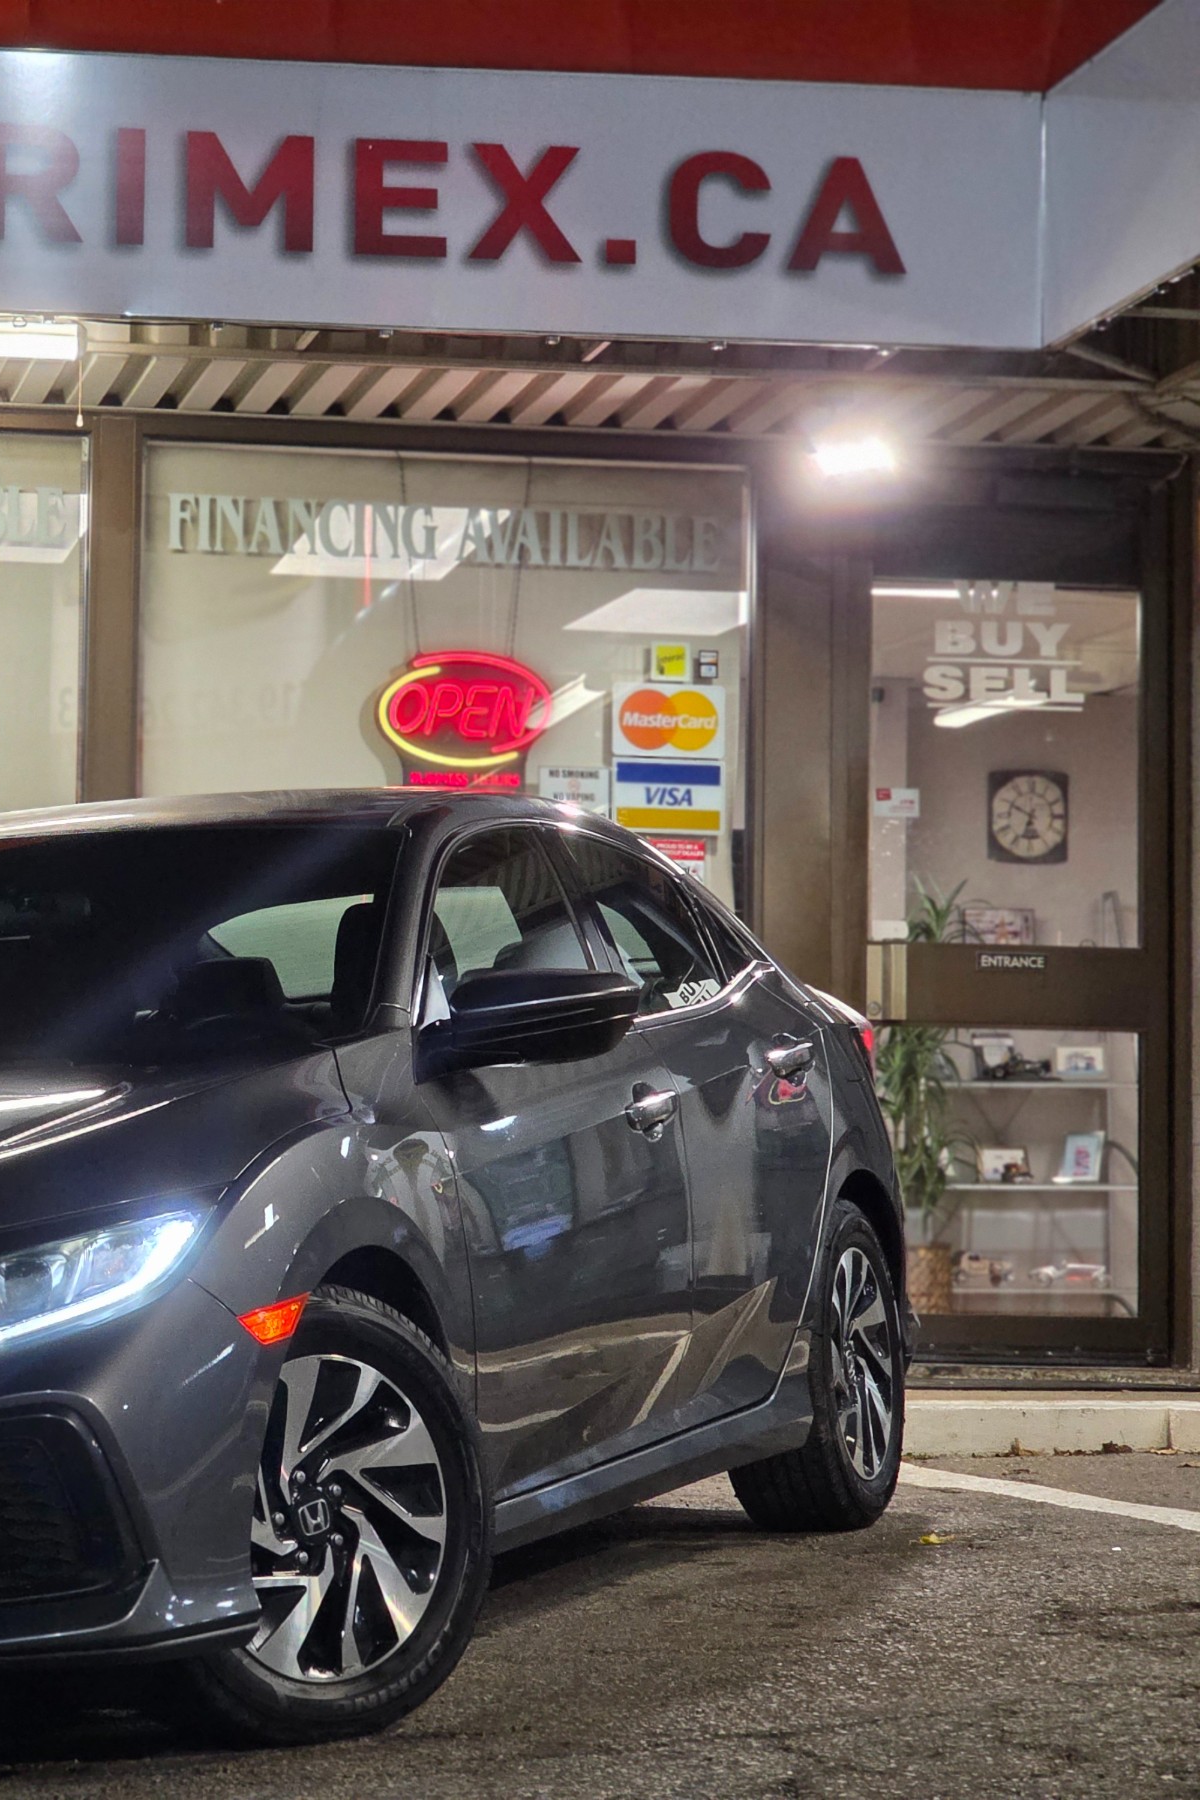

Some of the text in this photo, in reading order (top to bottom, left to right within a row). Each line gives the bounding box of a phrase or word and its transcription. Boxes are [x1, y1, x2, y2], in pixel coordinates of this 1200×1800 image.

[167, 492, 721, 572] FINANCING AVAILABLE
[934, 620, 1071, 657] BUY
[922, 664, 1086, 704] SELL
[388, 683, 535, 738] OPEN
[622, 710, 717, 730] MasterCard
[548, 769, 600, 779] NO SMOKING
[644, 786, 693, 806] VISA
[981, 955, 1045, 968] ENTRANCE
